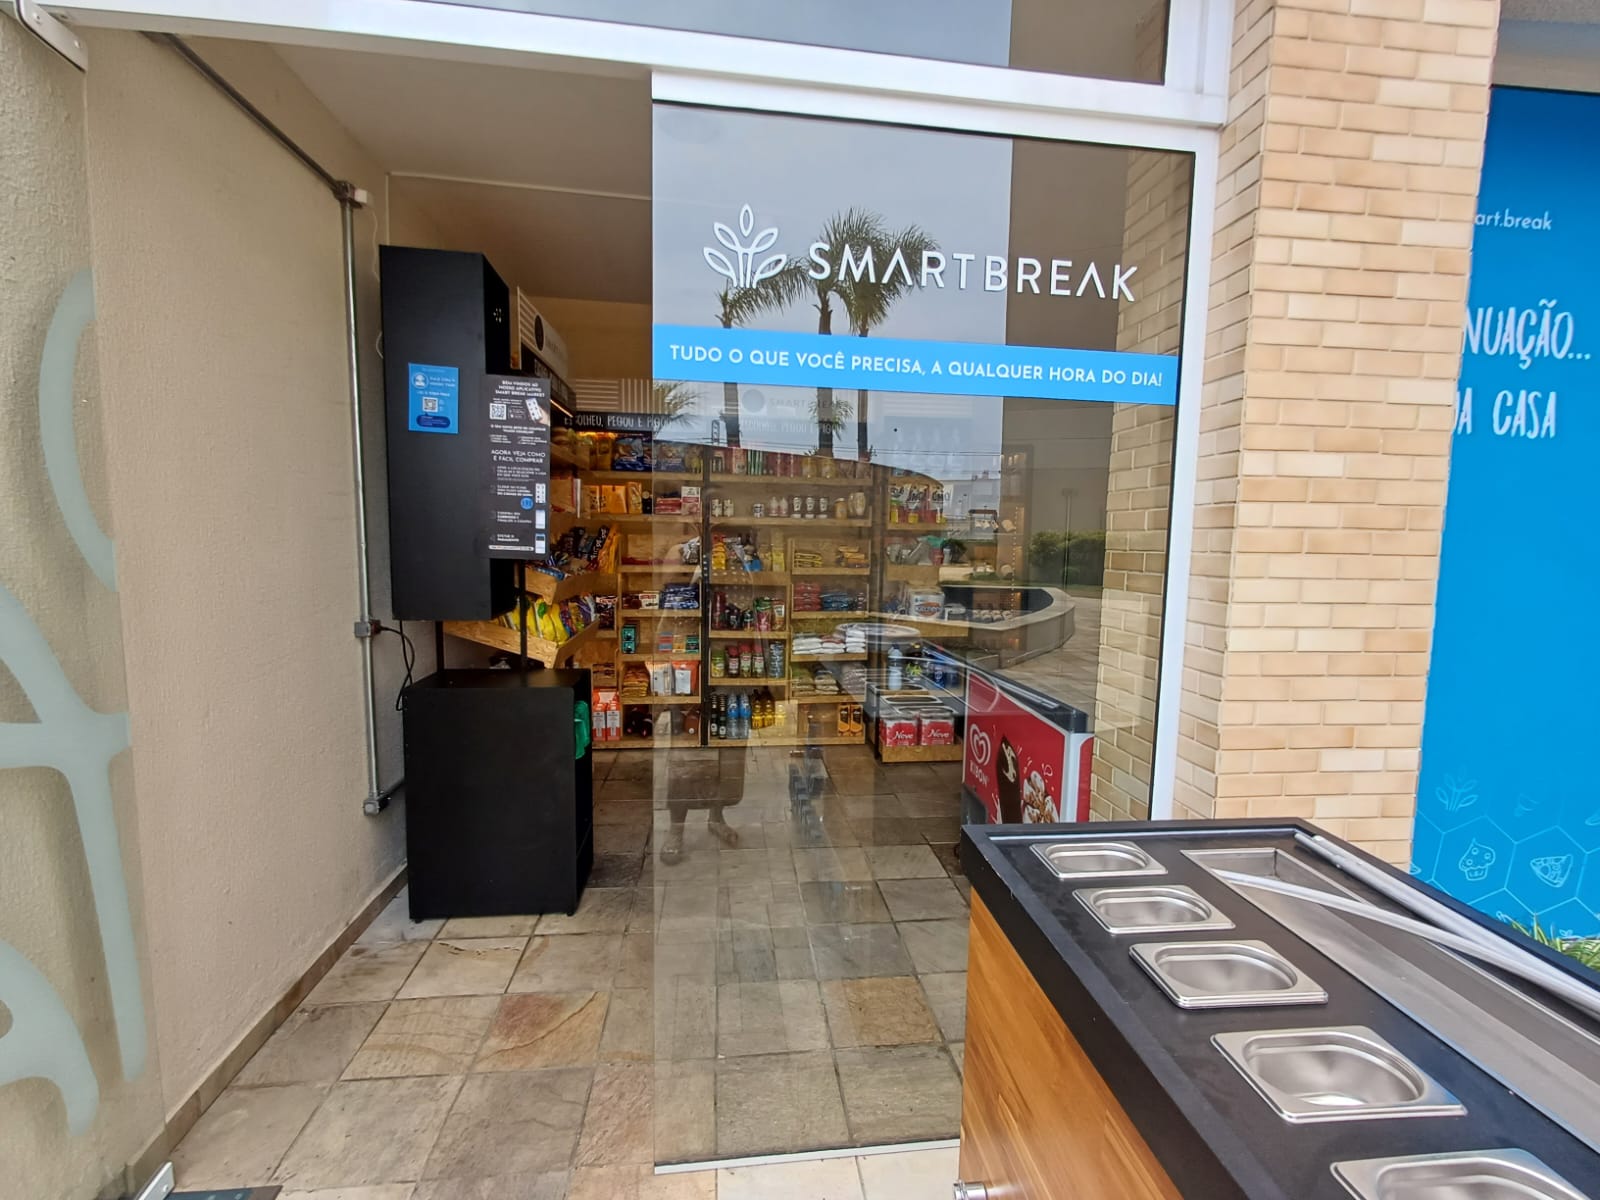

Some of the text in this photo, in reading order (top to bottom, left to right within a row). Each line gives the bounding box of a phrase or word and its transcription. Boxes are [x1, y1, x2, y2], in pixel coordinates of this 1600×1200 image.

[808, 240, 1139, 302] SMARTBREAK
[670, 344, 1162, 387] TUDO O QUE VOCÊ PRECISA, A QUALQUER HORA DO DIA!
[607, 415, 634, 427] PEGOU
[1454, 387, 1557, 440] A CASA
